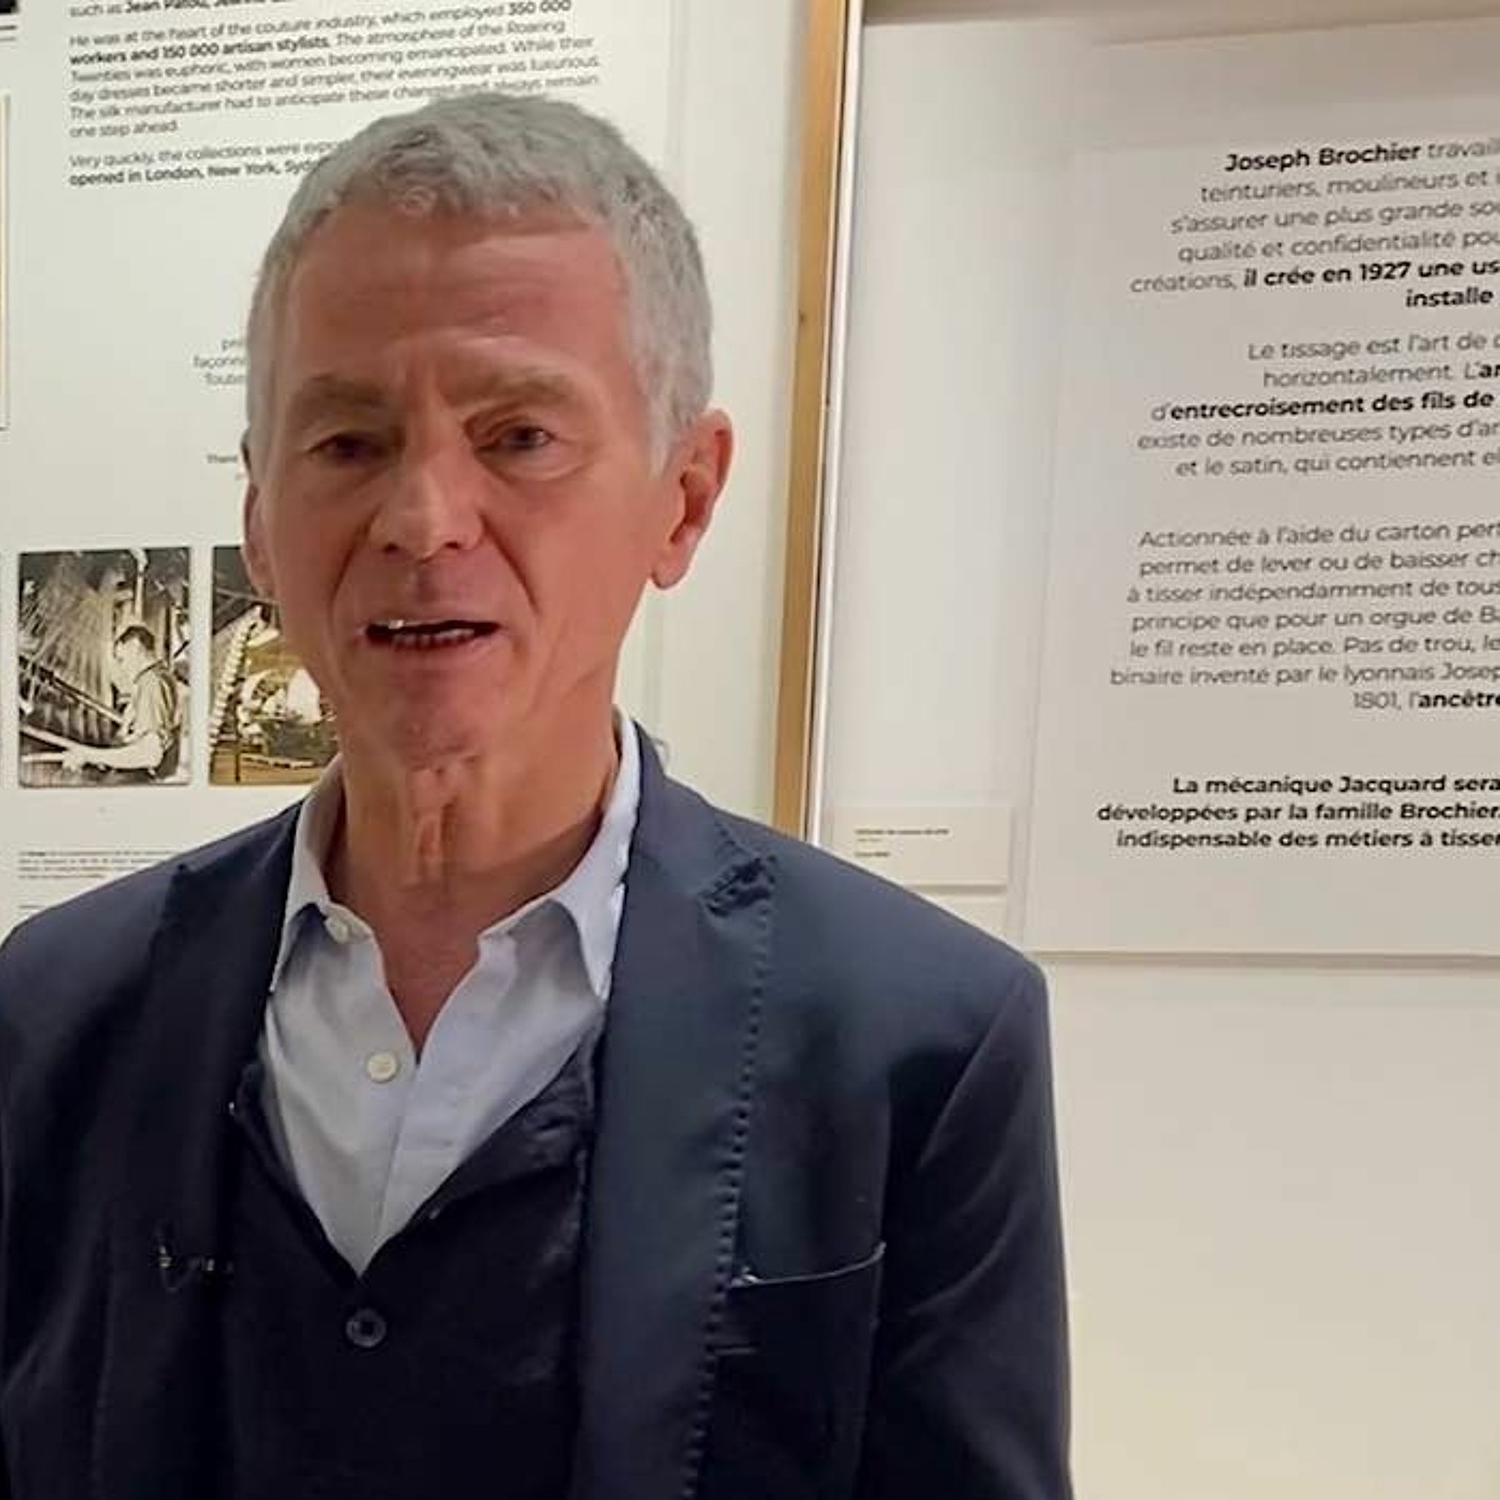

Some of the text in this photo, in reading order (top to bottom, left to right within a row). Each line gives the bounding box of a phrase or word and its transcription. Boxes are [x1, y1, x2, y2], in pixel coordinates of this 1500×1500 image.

[1224, 143, 1421, 175] Joseph Brochier
[1200, 169, 1488, 203] teinturiers, moulineurs et
[1170, 200, 1464, 232] s'assurer une plus grande
[1177, 231, 1456, 265] qualité et confidentialité
[1130, 271, 1235, 294] créations,
[1243, 270, 1256, 286] il
[1263, 267, 1315, 285] crée
[1321, 269, 1351, 282] en
[1359, 262, 1411, 280] 1927
[1417, 263, 1464, 277] une
[1405, 287, 1493, 306] installe
[1248, 342, 1275, 359] Le
[1280, 338, 1361, 362] tissage
[1365, 336, 1401, 353] est
[1455, 332, 1488, 349] de
[1152, 390, 1494, 419] d'entrecroisement des fils de
[1205, 429, 1235, 446] de
[1241, 424, 1383, 444] nombreuses
[1388, 421, 1452, 444] types
[1175, 459, 1197, 476] et
[1204, 458, 1224, 475] le
[1293, 454, 1330, 476] qui
[1334, 449, 1476, 469] contiennent
[1139, 522, 1450, 547] Actionnée à l'aide du carton
[1139, 550, 1469, 579] permet de lever ou de baisser
[1126, 586, 1140, 602] à
[1209, 580, 1413, 604] indépendamment
[1419, 579, 1451, 595] de
[1131, 607, 1473, 634] principe que pour un orgue de
[1129, 641, 1148, 657] le
[1154, 640, 1173, 656] fil
[1178, 639, 1233, 656] reste
[1238, 642, 1266, 655] en
[1342, 636, 1383, 653] Pas
[1387, 635, 1419, 652] de
[1423, 634, 1476, 653] trou,
[1110, 663, 1435, 686] binaire inventé par le lyonnais
[1173, 775, 1500, 797] La mécanique Jacquard sera
[1096, 804, 1238, 825] développées
[1244, 807, 1282, 824] par
[1288, 803, 1307, 819] la
[1315, 803, 1393, 819] famille
[1116, 830, 1272, 851] indispensable
[1278, 830, 1318, 846] des
[1324, 830, 1413, 846] métiers
[1419, 830, 1433, 846] à
